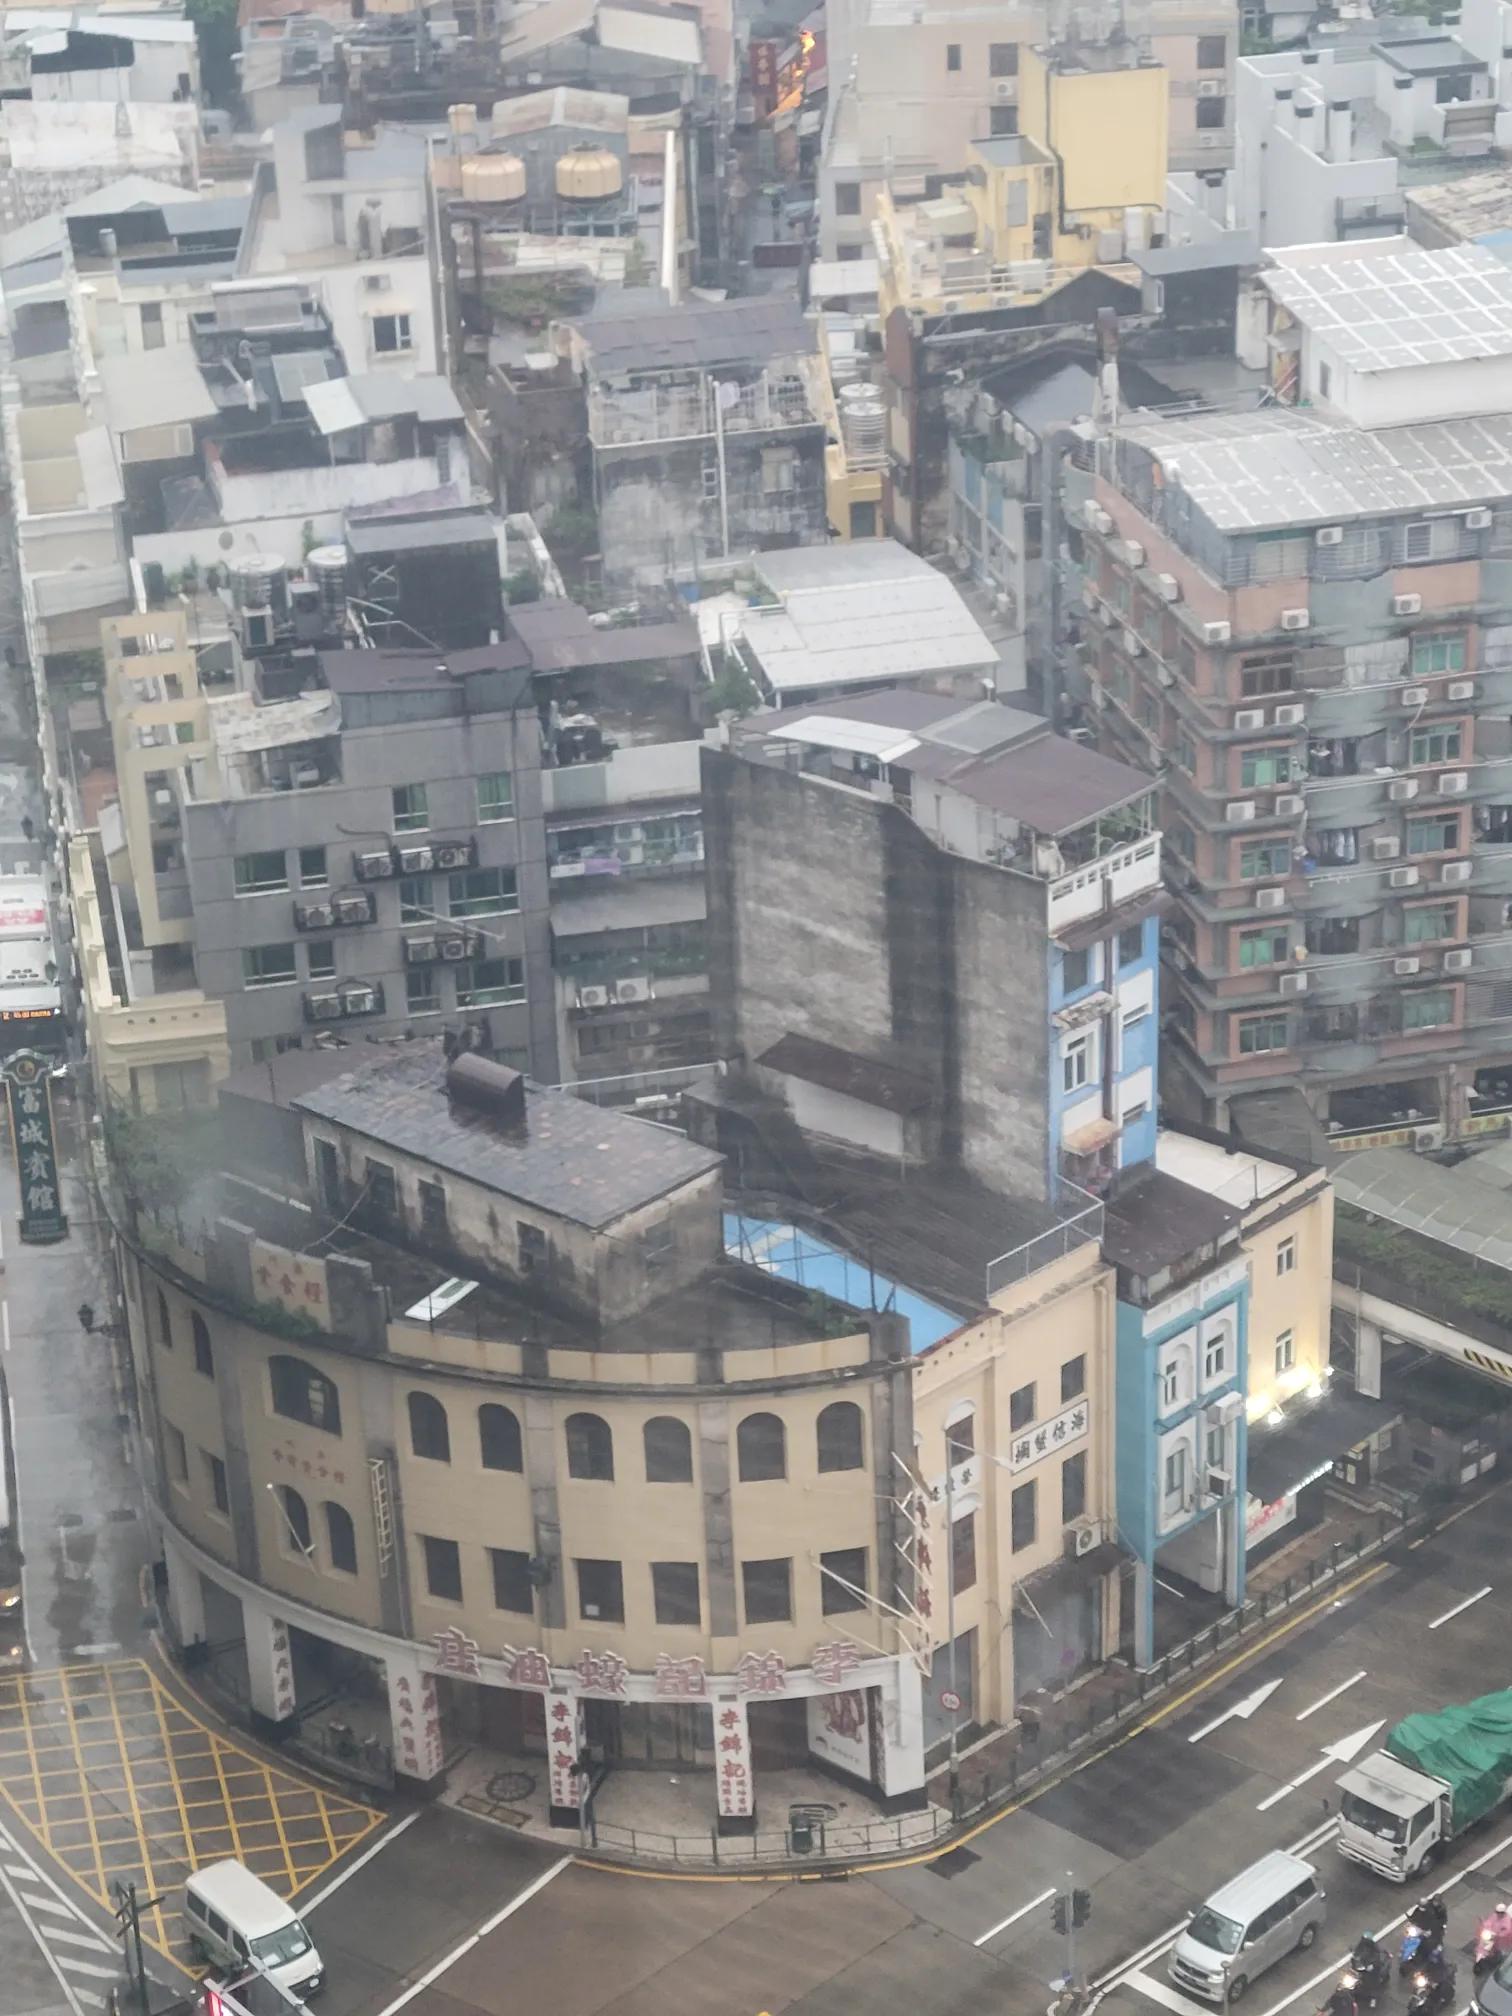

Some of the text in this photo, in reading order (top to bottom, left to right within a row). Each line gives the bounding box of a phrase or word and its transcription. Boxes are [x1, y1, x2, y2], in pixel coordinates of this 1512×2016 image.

[18, 1086, 55, 1211] 富城賓館
[719, 1708, 746, 1778] 李錦記
